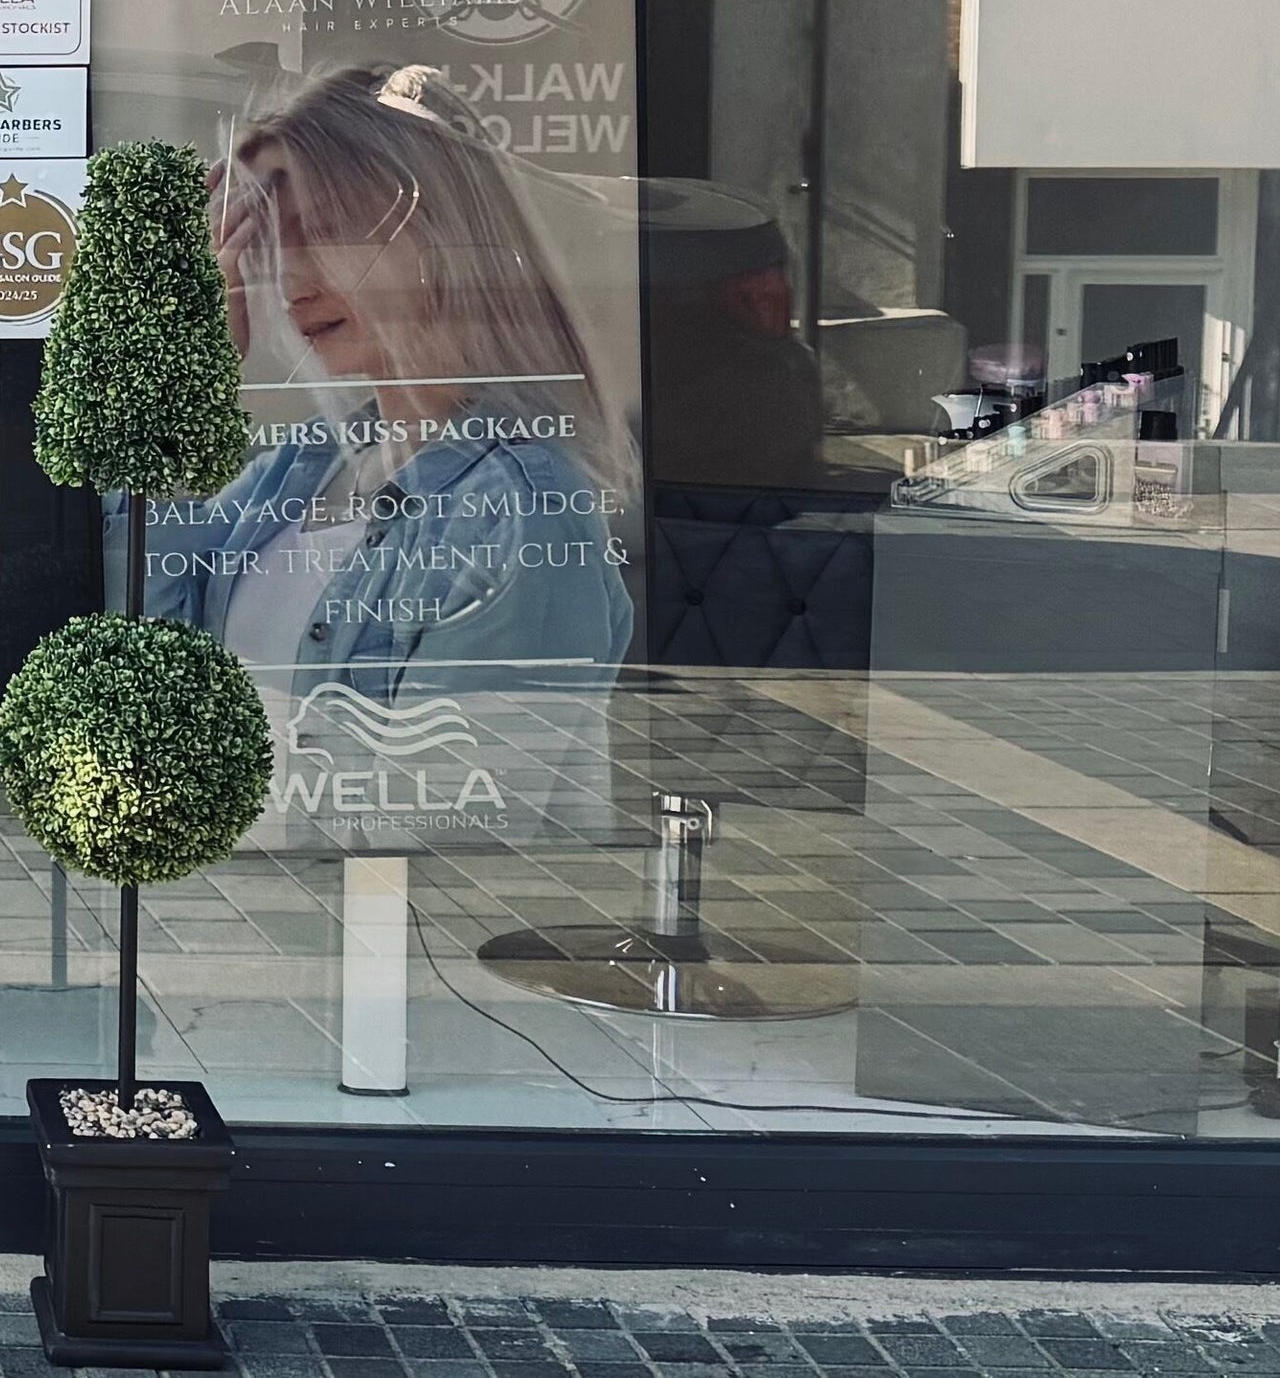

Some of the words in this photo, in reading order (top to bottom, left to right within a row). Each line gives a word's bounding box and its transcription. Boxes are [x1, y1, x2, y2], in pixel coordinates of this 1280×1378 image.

[2, 22, 71, 34] STOCKIST
[282, 20, 337, 33] HAIR
[354, 15, 459, 31] EXPERTS
[31, 273, 62, 283] GUIDE
[340, 420, 407, 444] KISS
[419, 414, 577, 442] PACKAGE
[145, 495, 336, 527] BALAYAGE,
[348, 493, 451, 521] ROOT
[462, 488, 626, 519] SMUDGE,
[144, 549, 269, 578] TONER,
[280, 543, 508, 574] TREATMENT,
[518, 539, 593, 568] CUT
[604, 536, 631, 566] &
[325, 596, 442, 625] FINISH
[268, 768, 507, 813] WELLA
[332, 813, 509, 832] PROFESSIONALS
